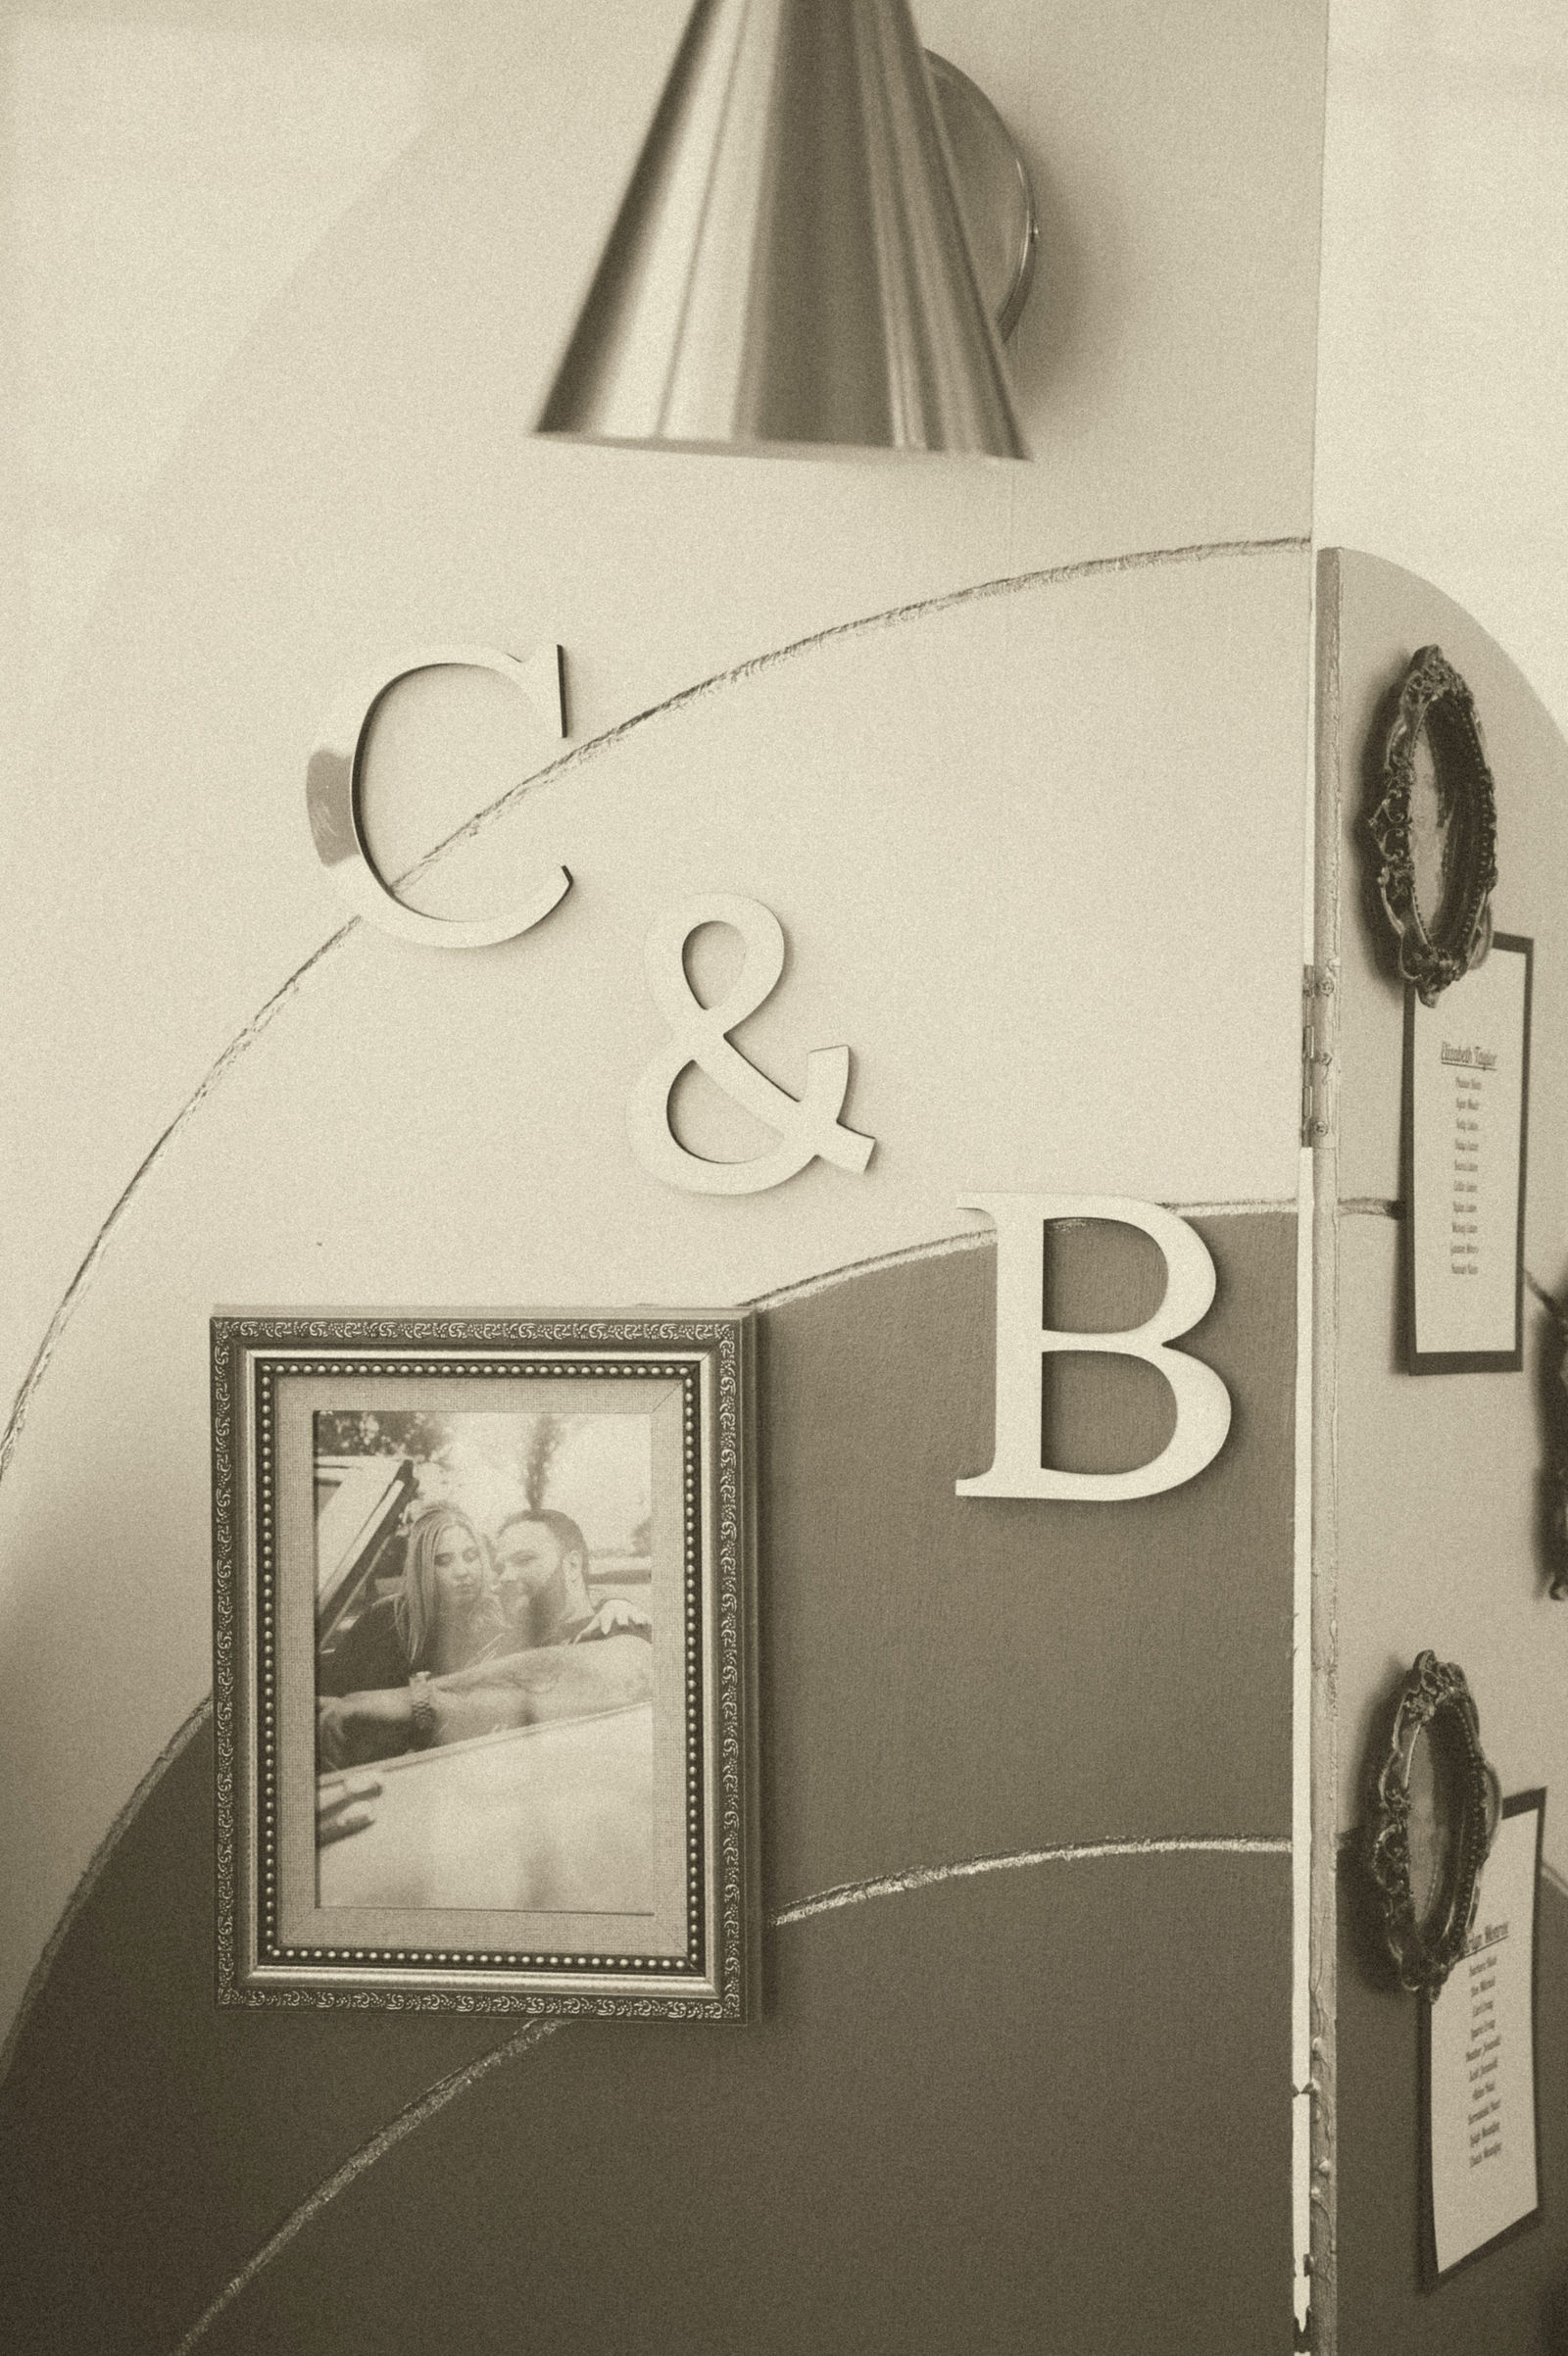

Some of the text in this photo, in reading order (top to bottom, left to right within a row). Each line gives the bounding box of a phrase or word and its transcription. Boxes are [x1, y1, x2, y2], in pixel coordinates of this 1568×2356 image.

[308, 643, 1233, 1502] C & B
